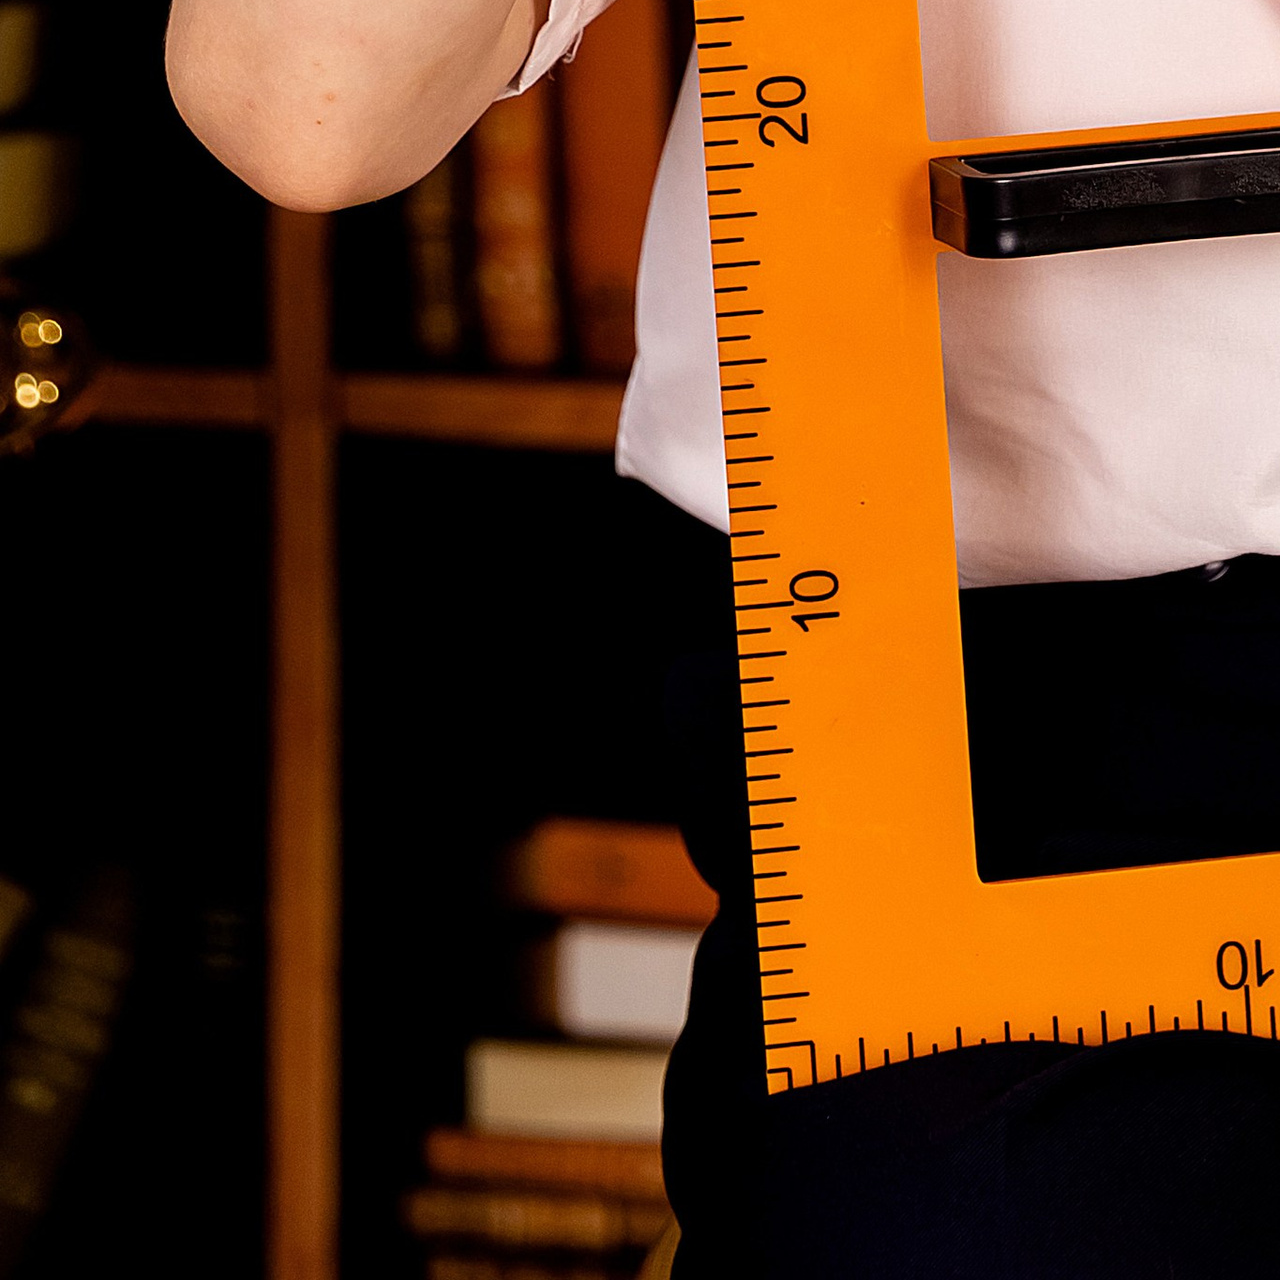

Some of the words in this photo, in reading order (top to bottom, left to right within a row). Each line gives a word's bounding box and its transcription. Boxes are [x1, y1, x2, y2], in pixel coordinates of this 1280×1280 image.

[755, 75, 809, 148] 20
[789, 569, 841, 633] 10
[1216, 938, 1275, 991] 10
